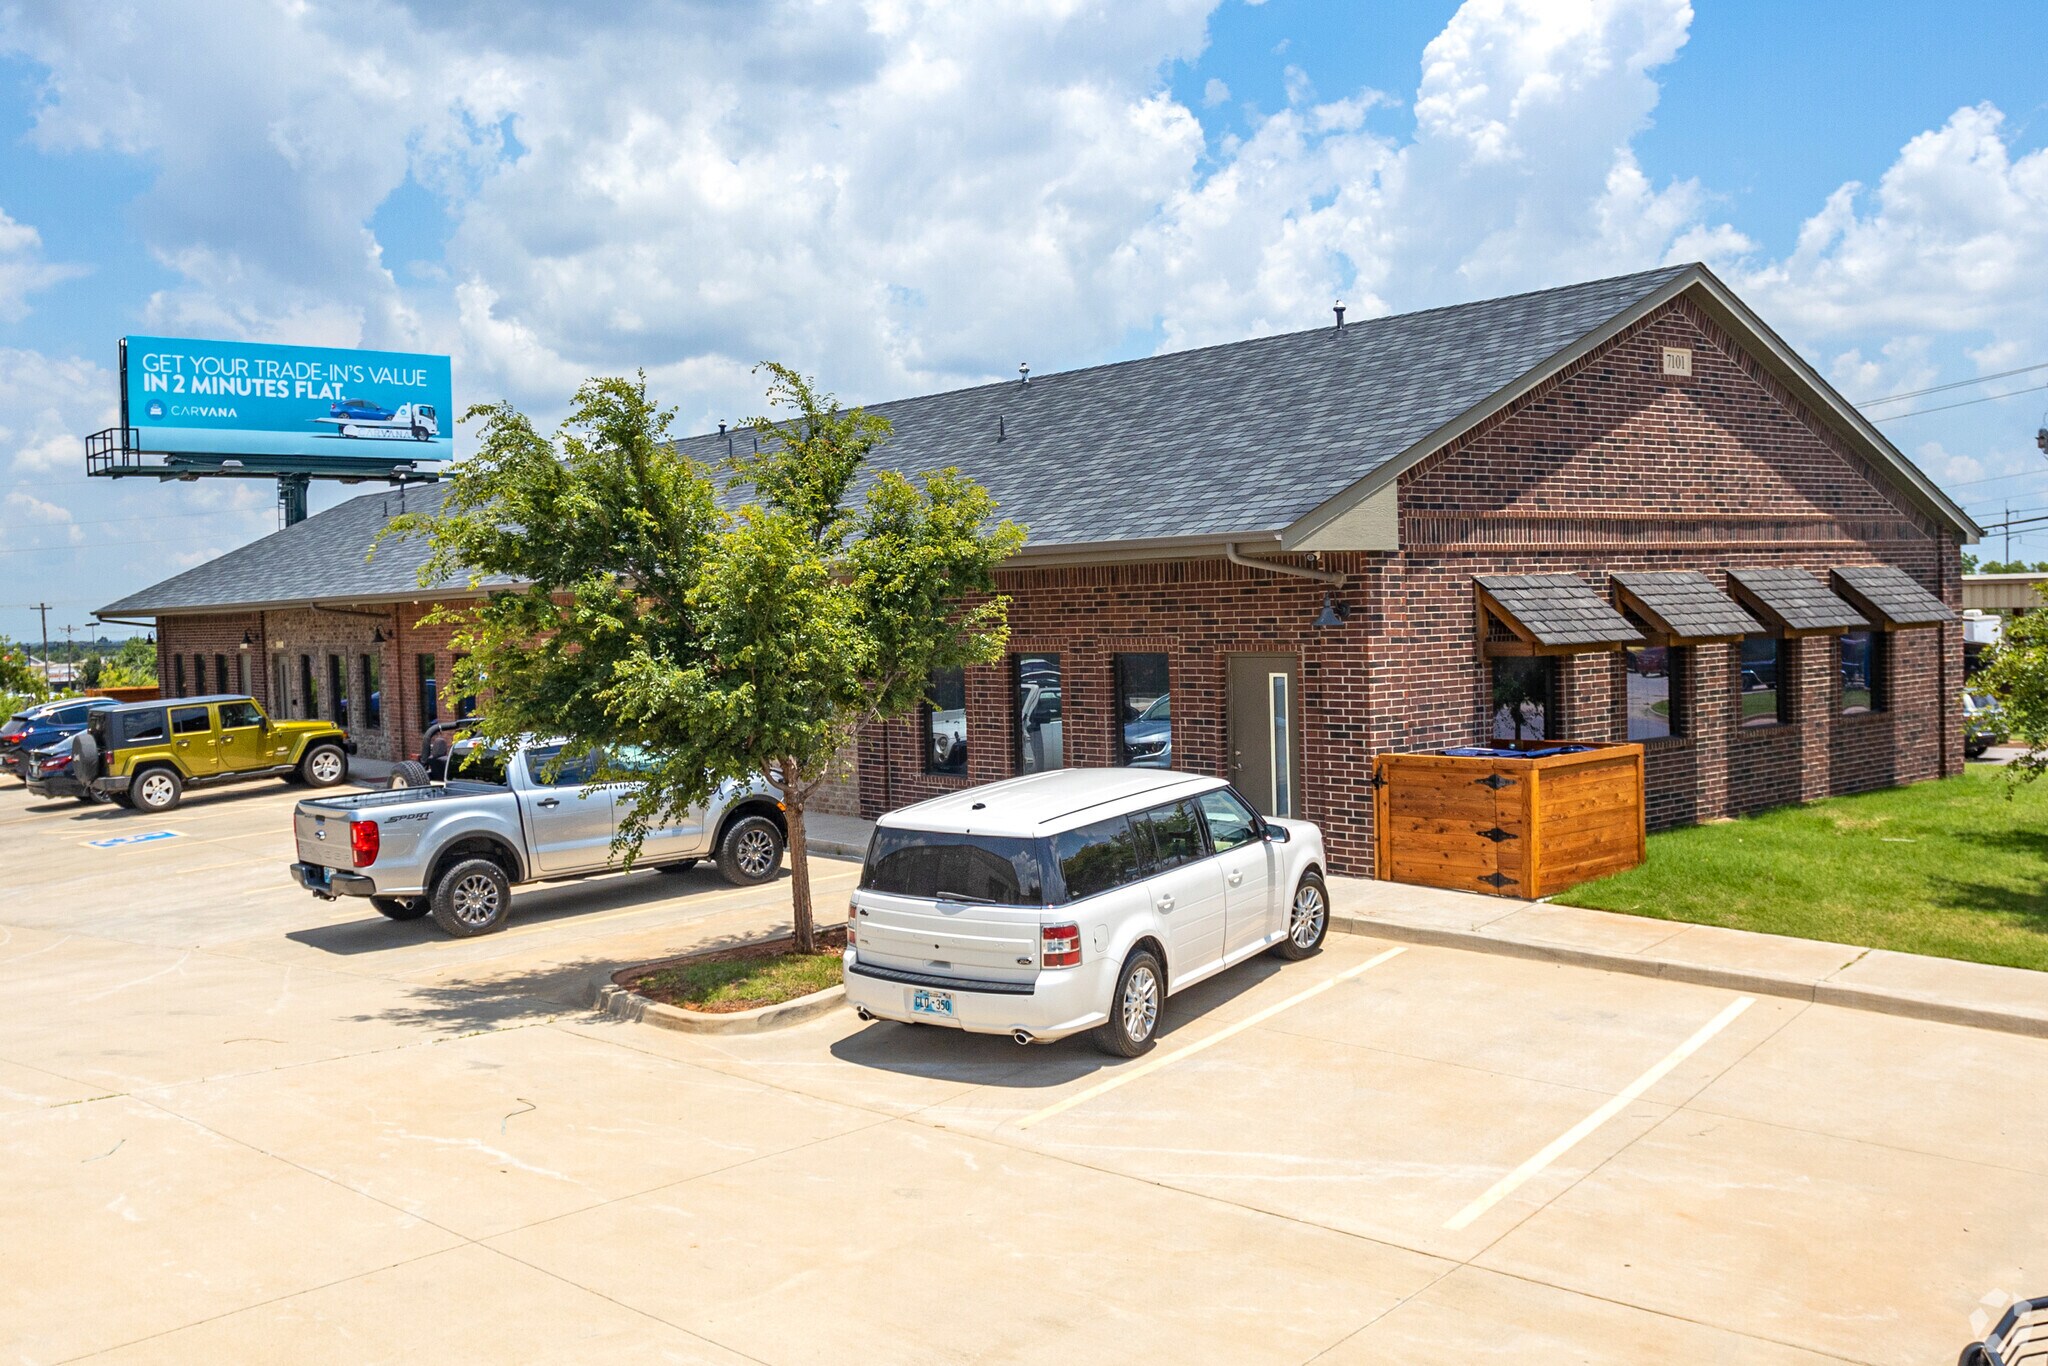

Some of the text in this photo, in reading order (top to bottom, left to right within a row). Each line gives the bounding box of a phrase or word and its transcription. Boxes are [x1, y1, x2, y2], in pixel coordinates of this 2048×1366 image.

[1666, 354, 1685, 370] 7101
[142, 353, 427, 387] GET YOUR TRADE-IN'S VALUE
[143, 373, 346, 400] IN 2 MINUTES FLAT.
[171, 405, 238, 418] CARVANA
[358, 427, 411, 439] CARVANA
[384, 811, 434, 824] SPORT
